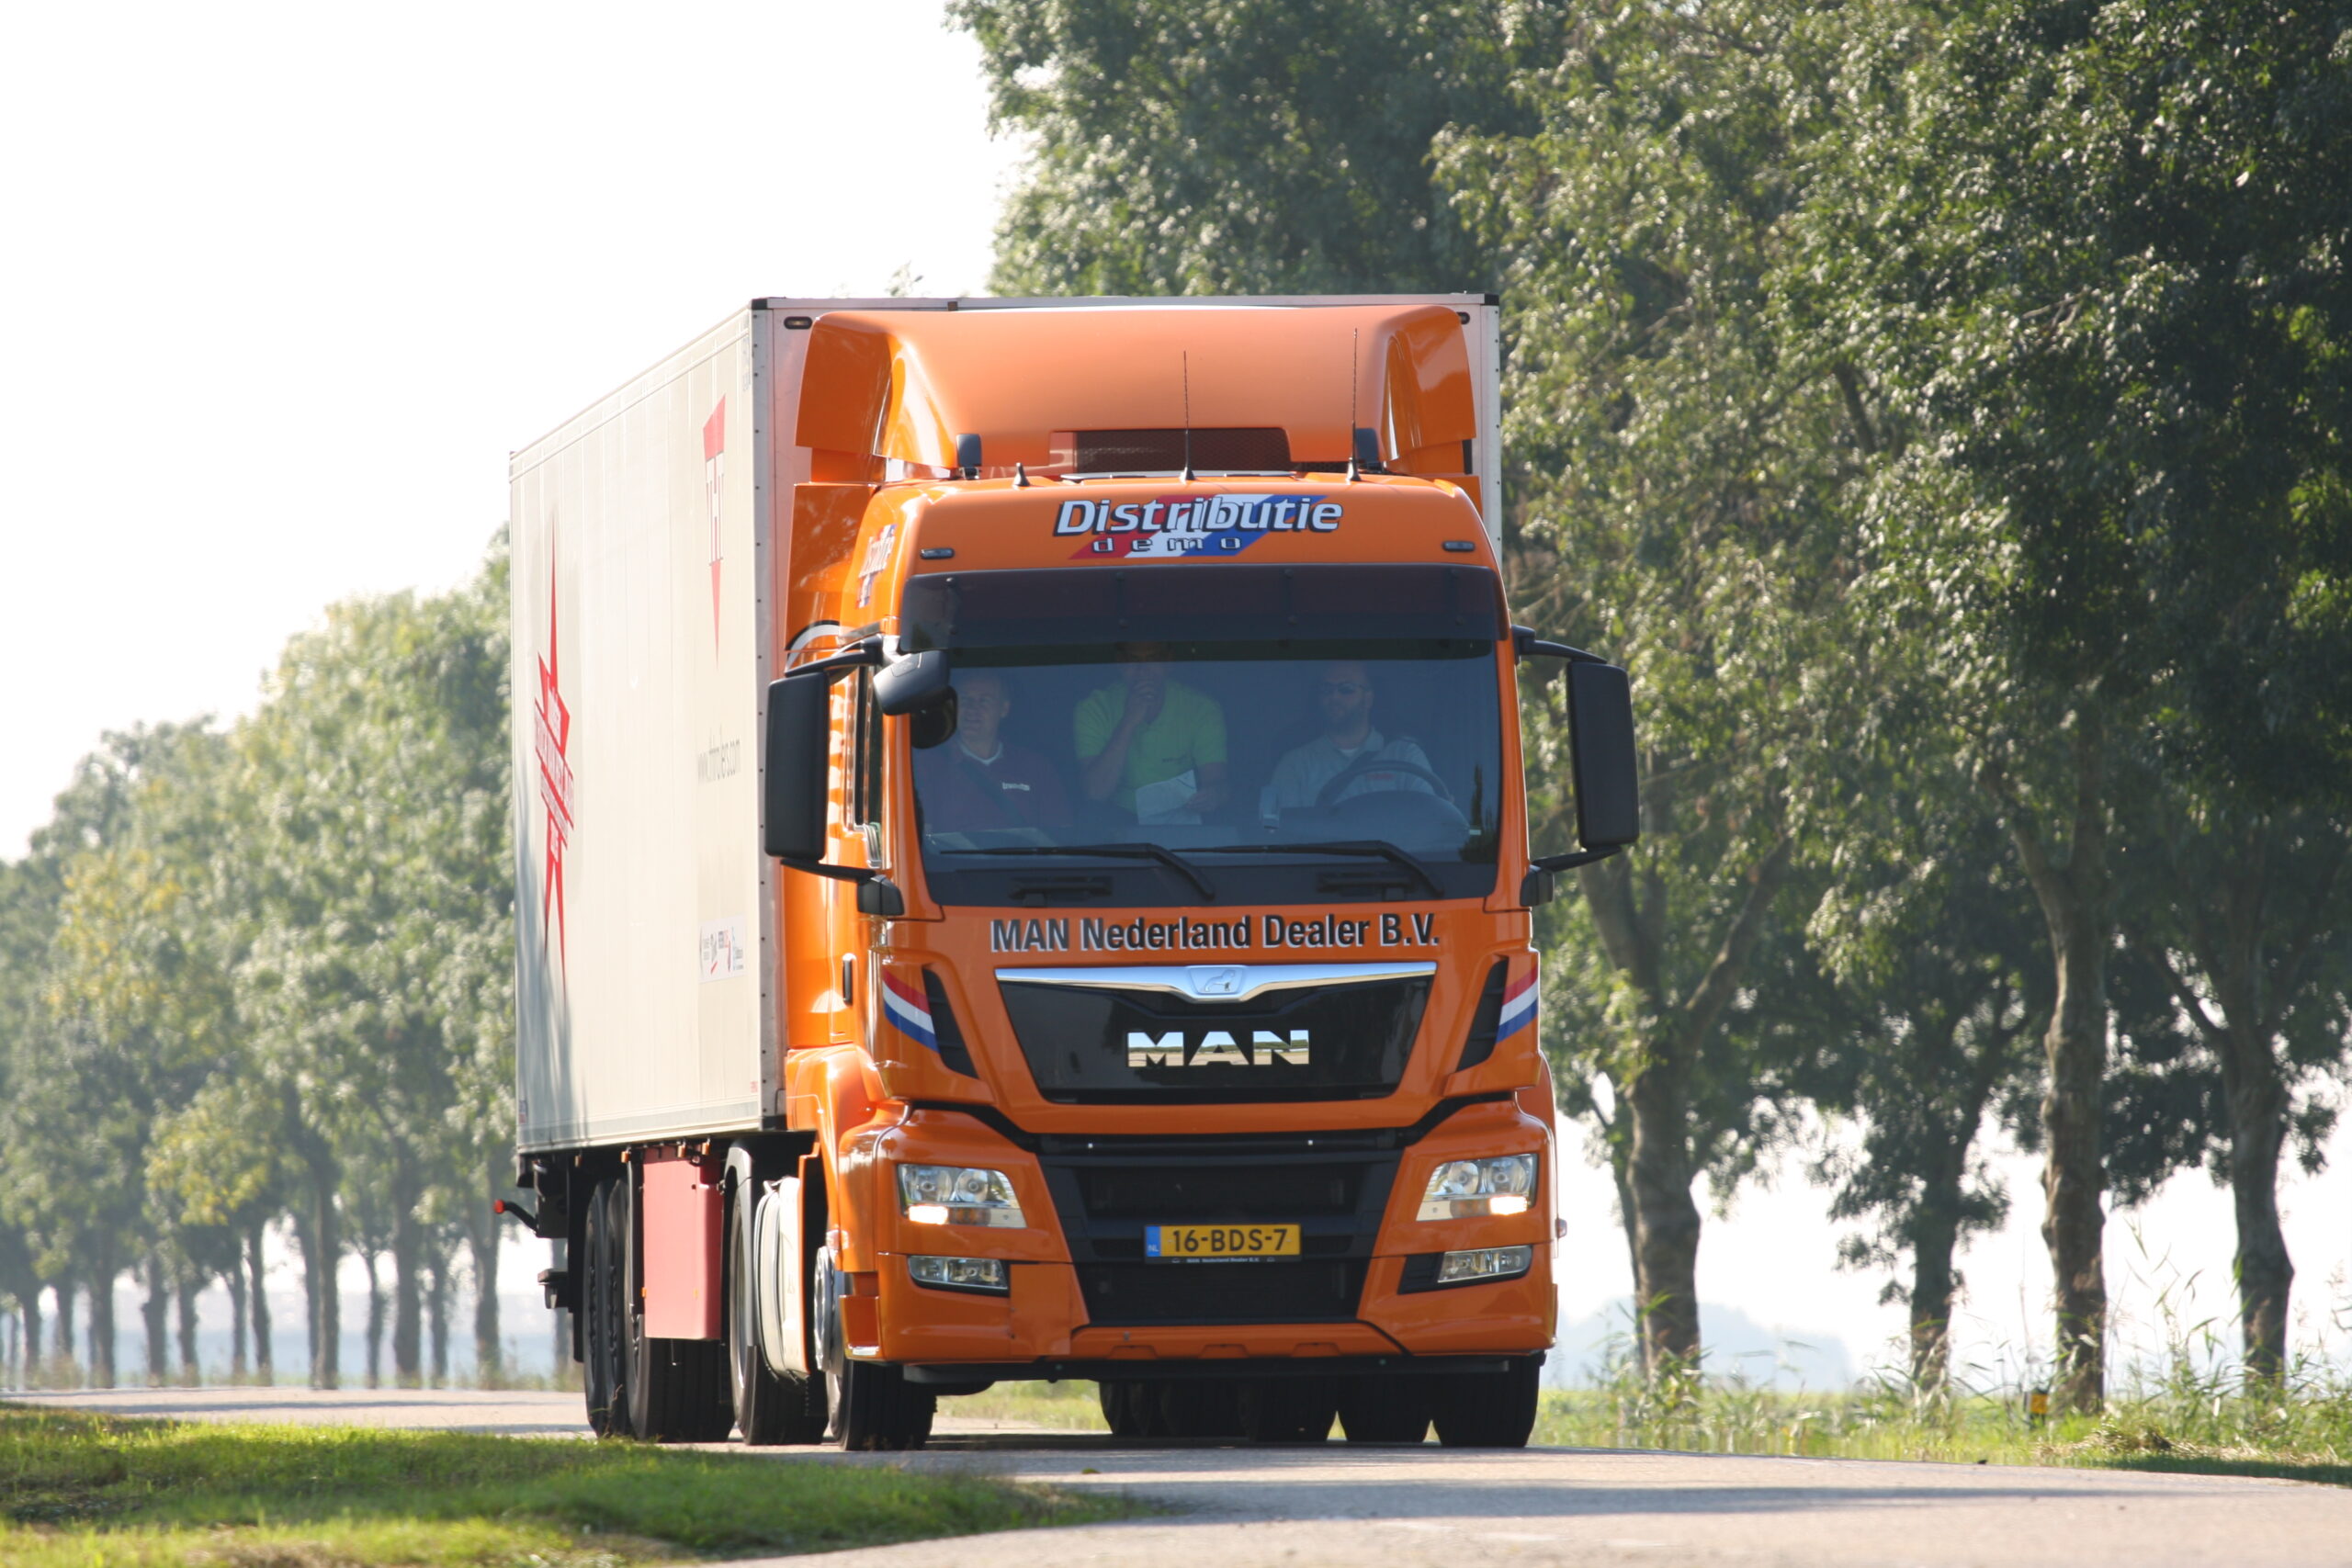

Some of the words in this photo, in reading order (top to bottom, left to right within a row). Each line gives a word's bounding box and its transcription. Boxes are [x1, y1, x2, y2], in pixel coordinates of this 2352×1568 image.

[1053, 497, 1343, 536] Distributie
[1091, 536, 1242, 553] demo
[990, 917, 1069, 953] MAN
[1080, 915, 1251, 951] Nederland
[1261, 914, 1370, 949] Dealer
[1380, 913, 1439, 947] B.V.
[1127, 1029, 1309, 1067] MAN
[1148, 1244, 1159, 1253] NL
[1172, 1228, 1288, 1252] 16-BDS-7
